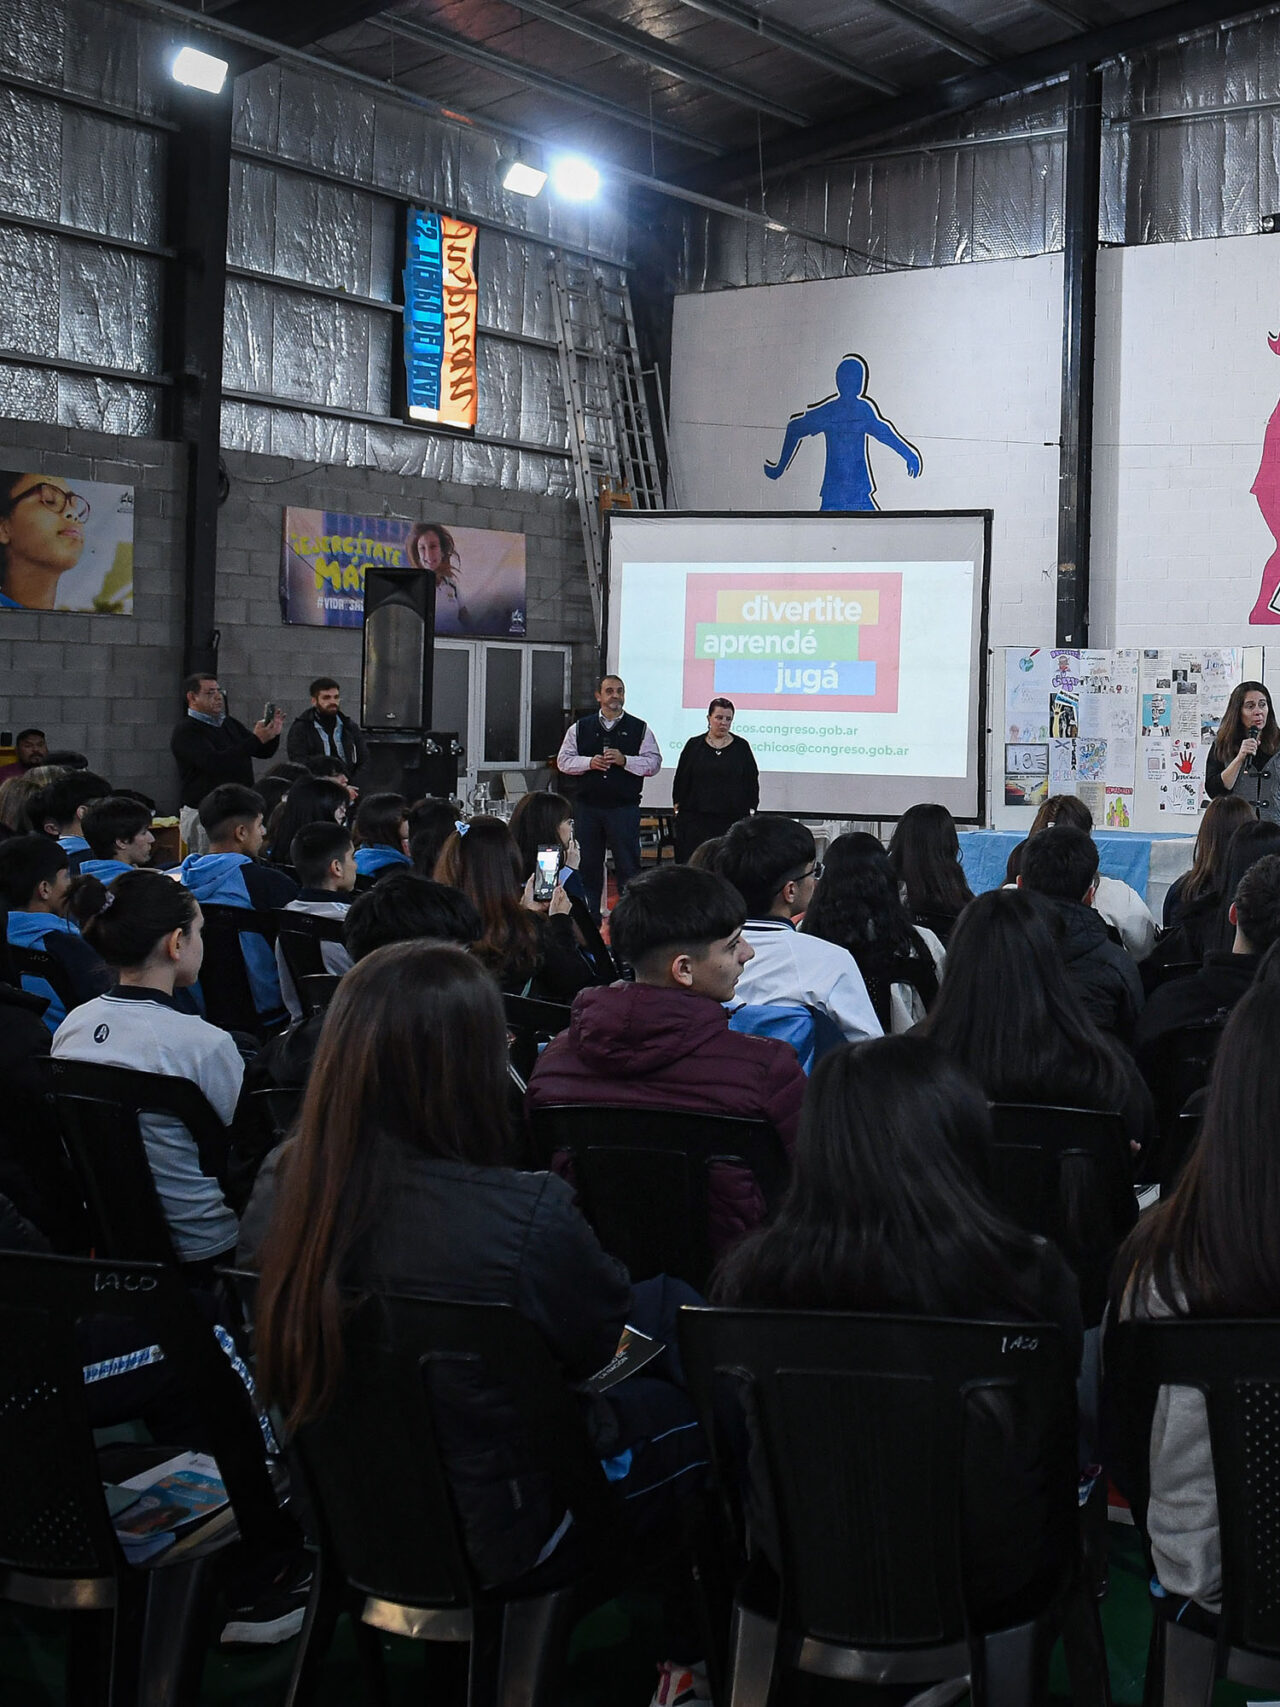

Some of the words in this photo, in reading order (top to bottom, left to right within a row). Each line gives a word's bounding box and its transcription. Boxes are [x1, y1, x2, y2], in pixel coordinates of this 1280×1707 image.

[742, 595, 863, 622] divertite
[703, 628, 818, 658] aprendé
[774, 661, 839, 693] jugá
[731, 722, 859, 737] icos.congreso.gob.ar
